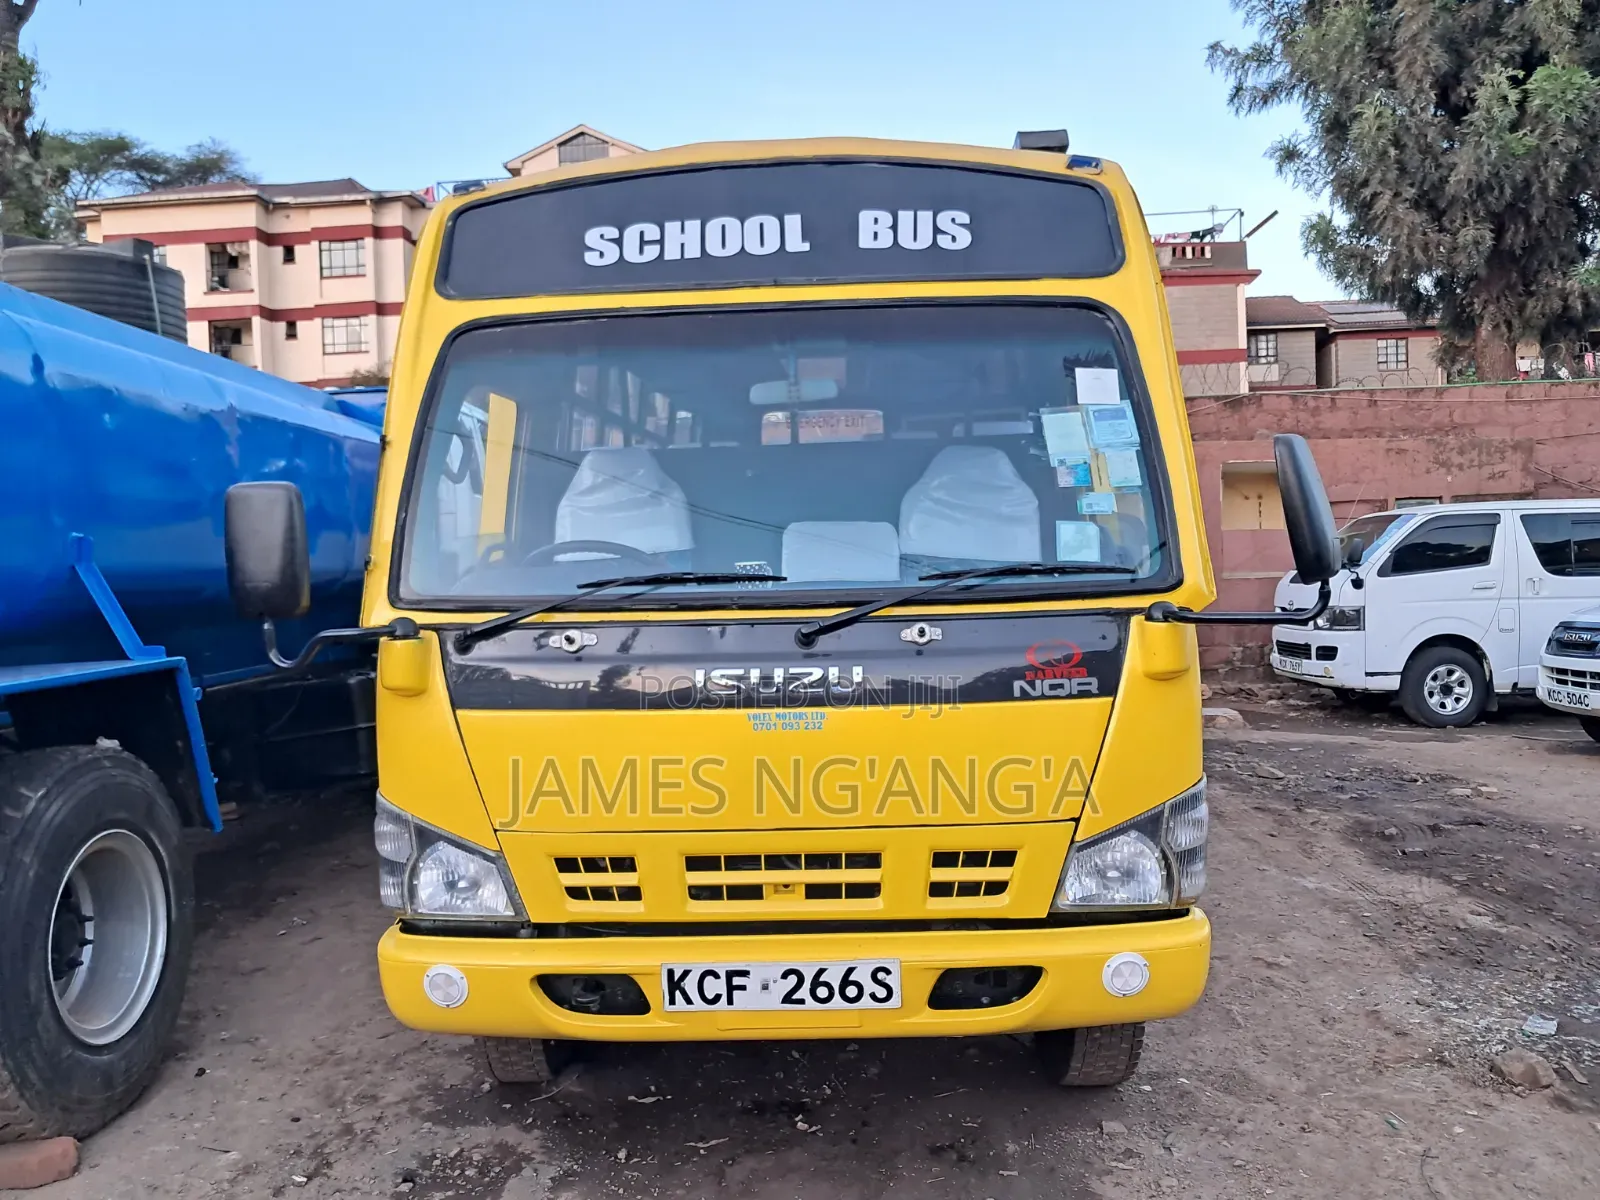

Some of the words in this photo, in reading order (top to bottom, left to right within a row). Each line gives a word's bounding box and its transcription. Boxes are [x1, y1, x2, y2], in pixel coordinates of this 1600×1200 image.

[583, 214, 810, 267] SCHOOL
[858, 210, 972, 251] BUS
[1564, 632, 1591, 642] ISUZU
[694, 665, 863, 697] ISUZU
[1013, 677, 1099, 698] NQR
[1546, 688, 1563, 703] KCC
[1566, 692, 1590, 708] 504C
[747, 712, 772, 722] VOLEX
[775, 712, 808, 721] MOTORS
[753, 722, 777, 731] 0701
[781, 721, 801, 731] 093
[804, 721, 823, 730] 232
[666, 968, 751, 1006] KCF
[780, 966, 894, 1005] 266S
